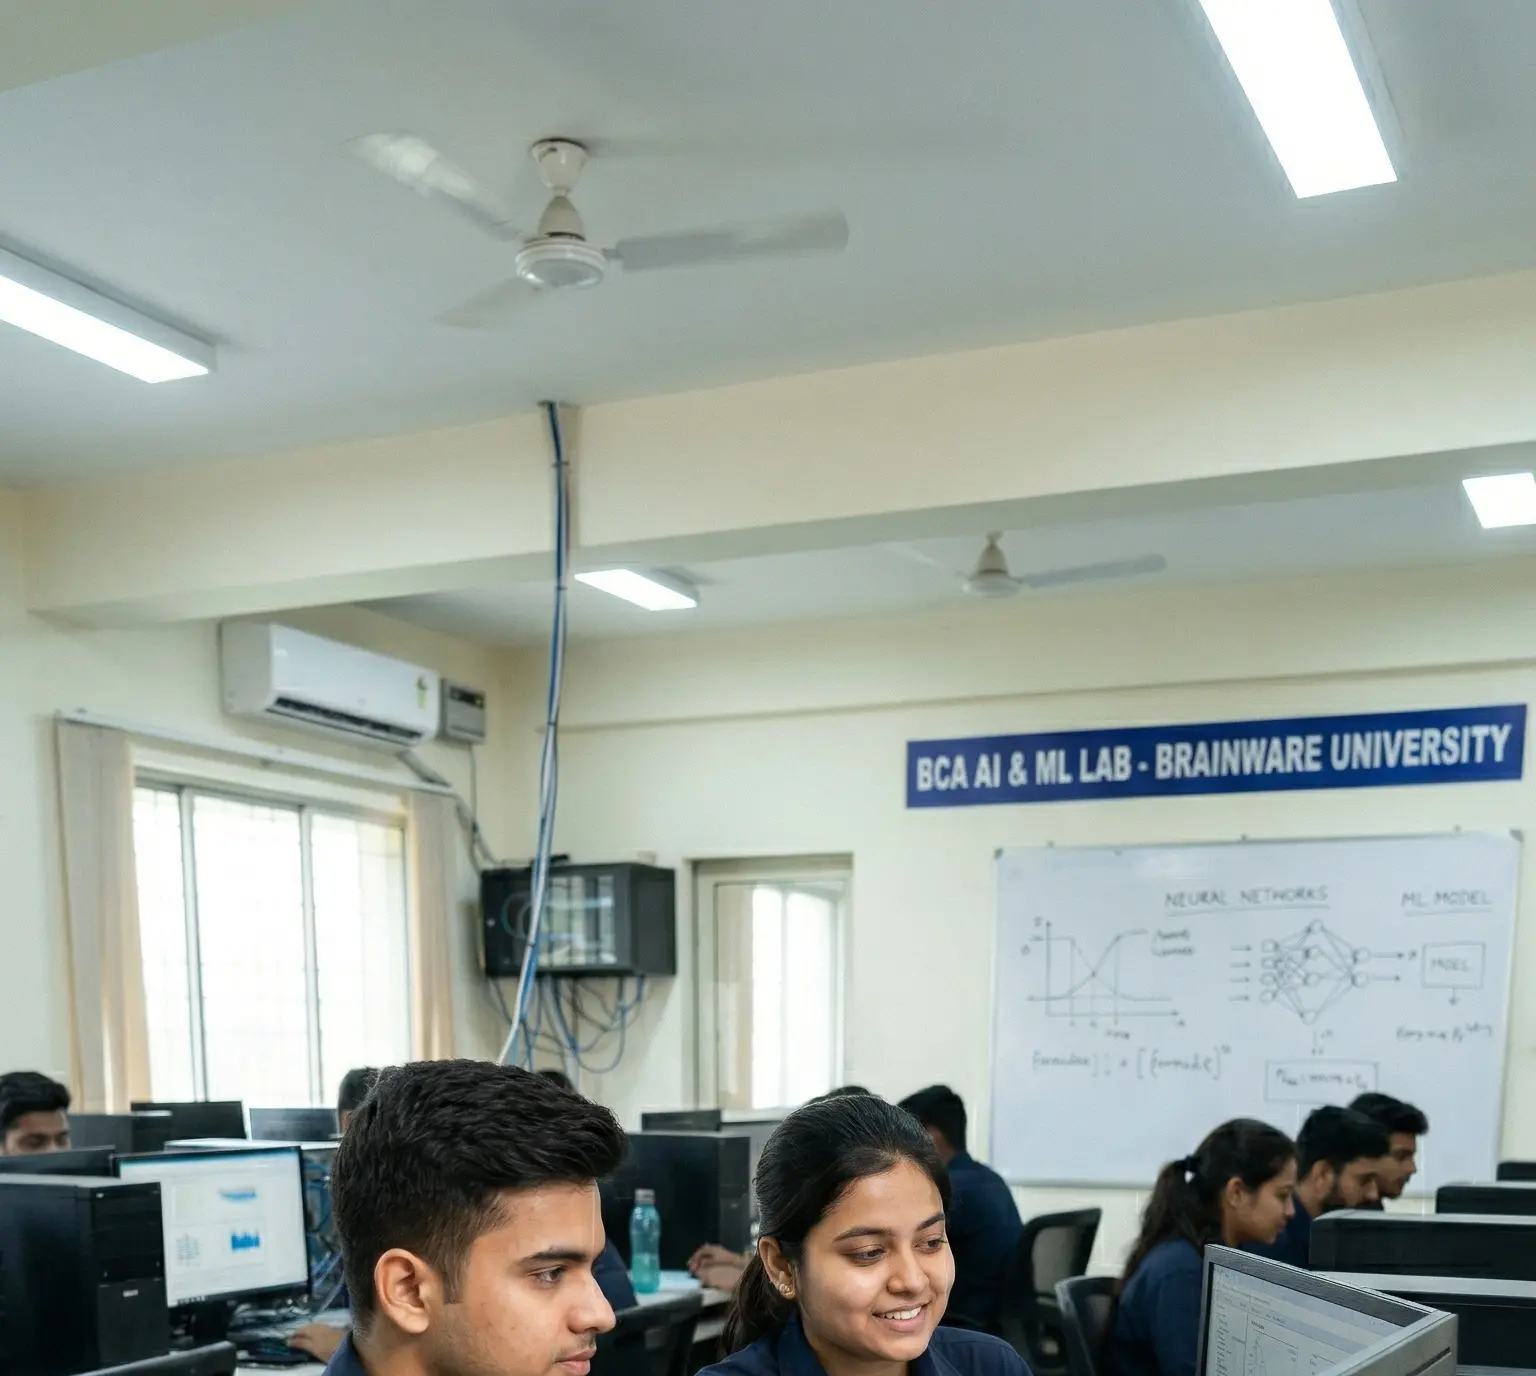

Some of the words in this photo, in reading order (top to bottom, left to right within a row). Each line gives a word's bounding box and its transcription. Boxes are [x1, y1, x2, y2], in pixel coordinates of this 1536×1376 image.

[916, 754, 968, 791] BCA
[974, 753, 1001, 789] AI
[1007, 752, 1030, 786] &
[1035, 749, 1073, 785] ML
[1079, 745, 1132, 783] LAB
[1155, 735, 1322, 780] BRAINWARE
[1329, 724, 1511, 770] UNIVERSITY
[1165, 889, 1227, 908] NEURAL
[1240, 885, 1329, 904] NETWORKS
[1400, 890, 1428, 907] ML
[1434, 889, 1492, 906] MODEL
